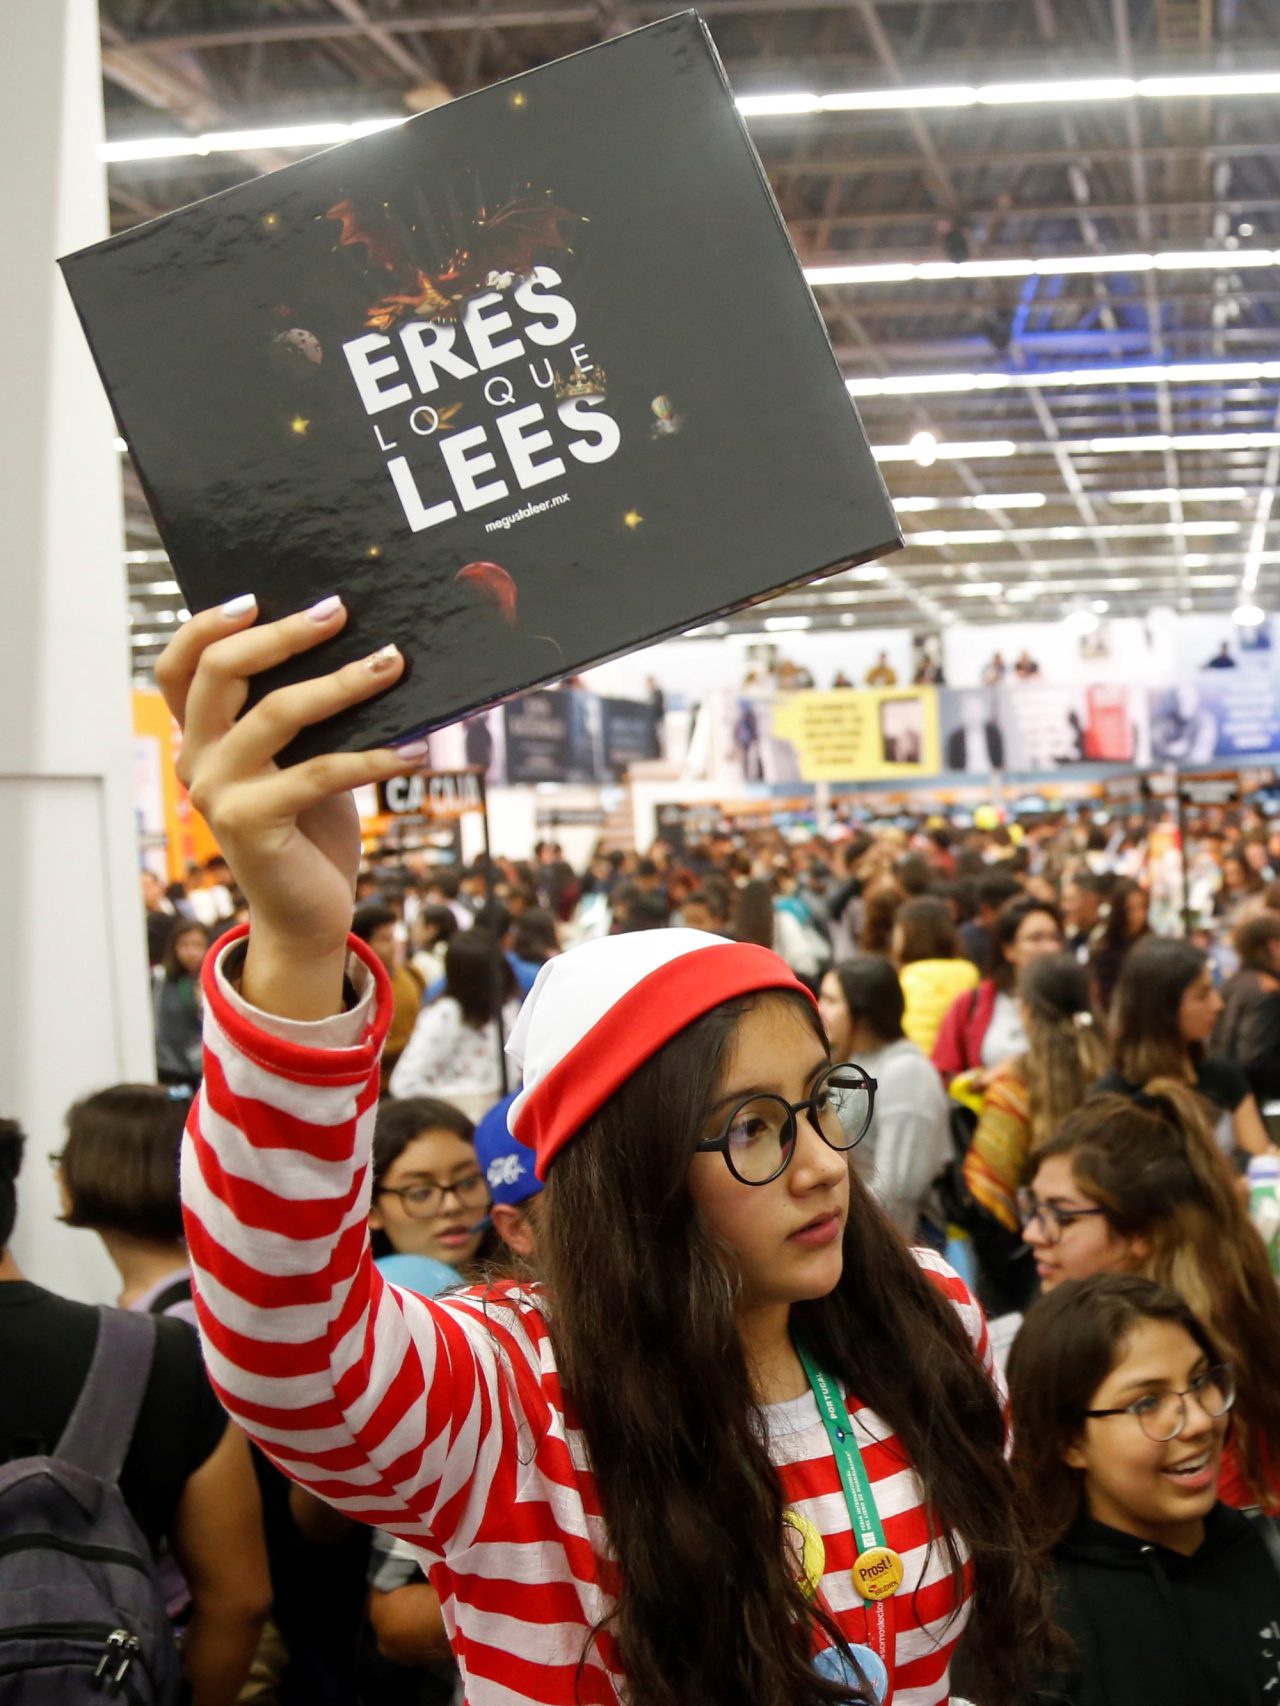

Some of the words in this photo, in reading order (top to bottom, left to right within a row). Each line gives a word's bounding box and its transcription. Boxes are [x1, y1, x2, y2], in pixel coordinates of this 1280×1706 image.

[342, 265, 577, 416] ERES
[373, 405, 440, 452] LO
[483, 343, 594, 406] QUE
[386, 396, 621, 533] LEES
[484, 492, 570, 533] megustaleer.mx
[816, 1371, 838, 1420] PORTUGAL
[859, 1555, 892, 1582] Prost!
